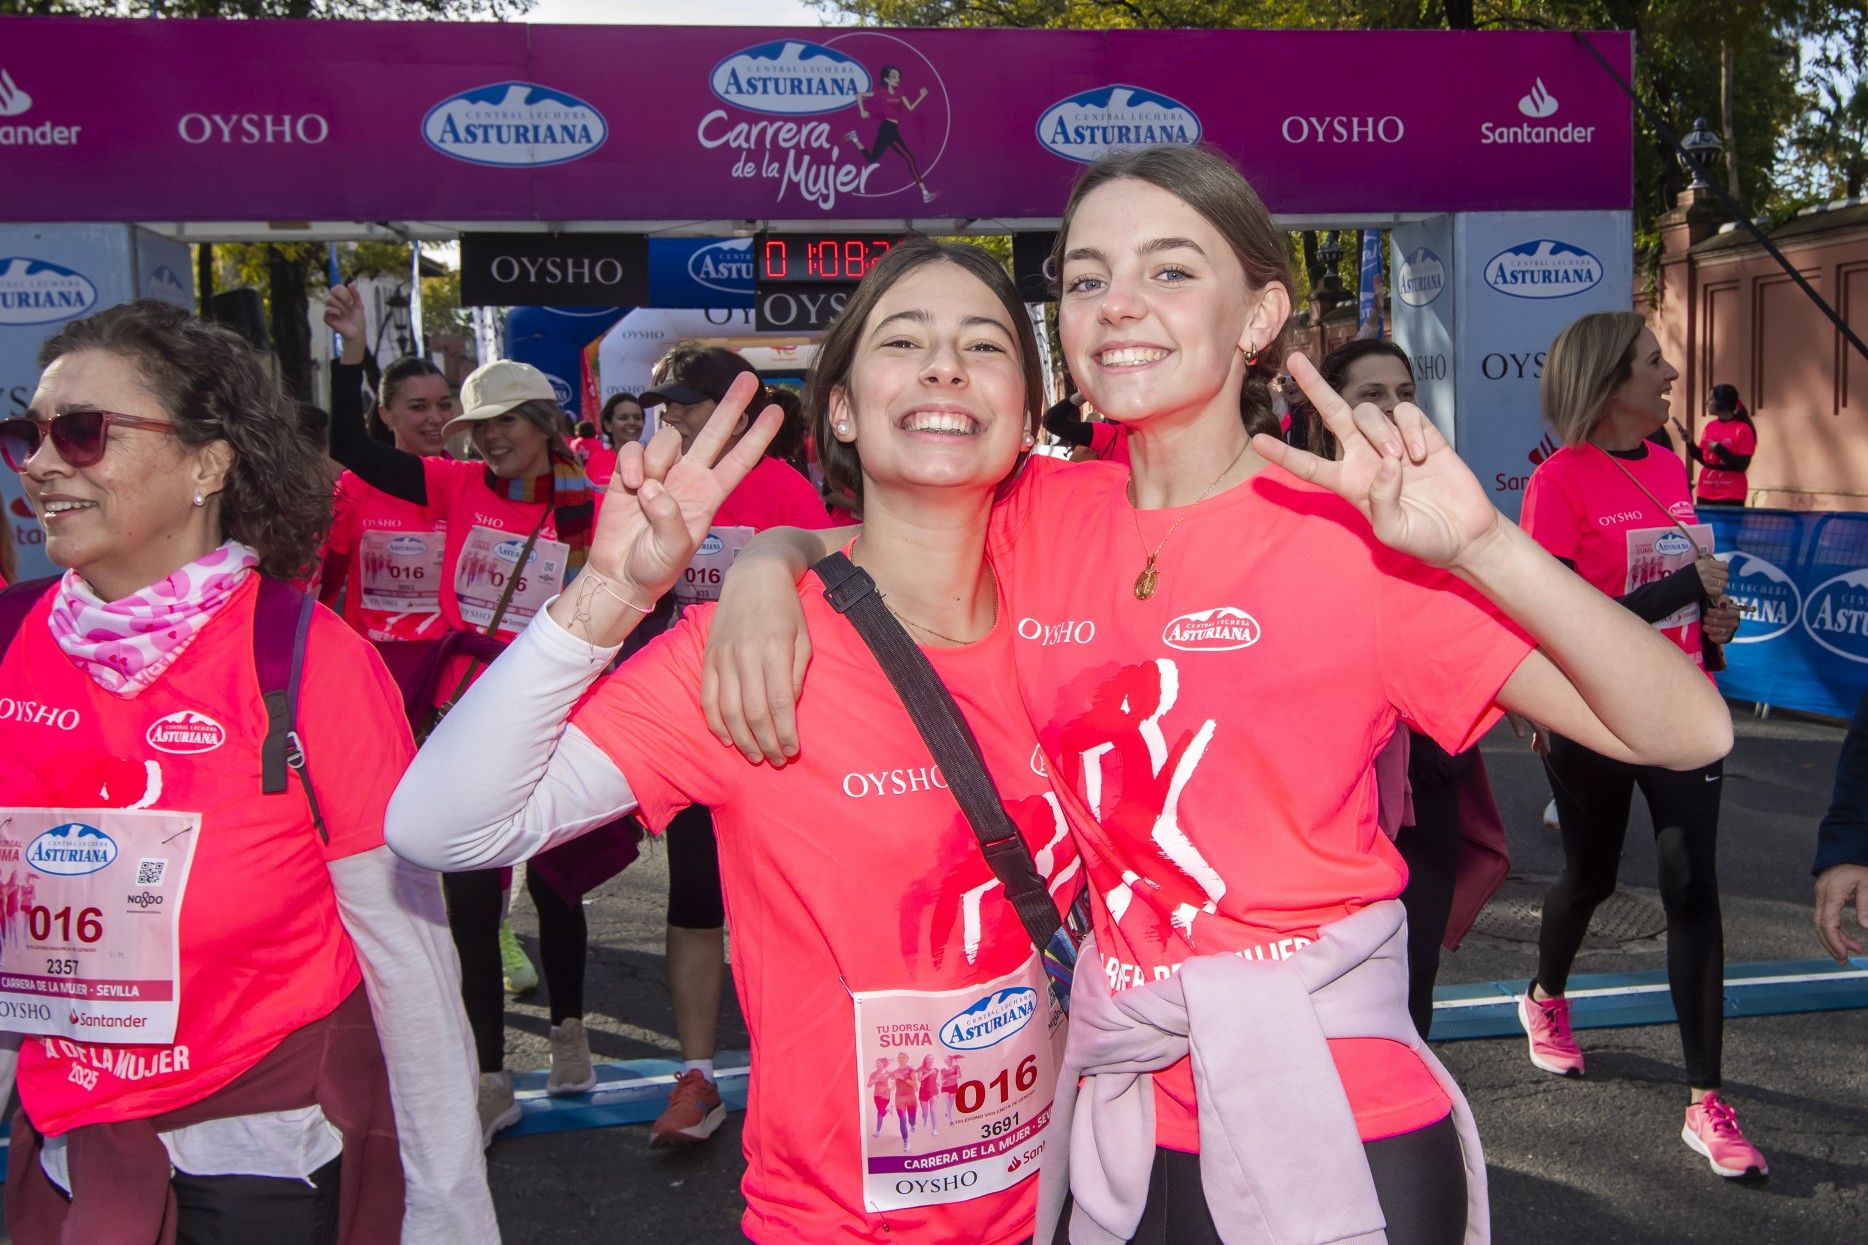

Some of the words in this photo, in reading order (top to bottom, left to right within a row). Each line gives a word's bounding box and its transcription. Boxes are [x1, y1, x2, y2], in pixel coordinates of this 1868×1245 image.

[724, 67, 858, 96] ASTURIANA
[0, 121, 81, 145] ander
[178, 113, 329, 144] OYSHO
[438, 113, 594, 144] ASTURIANA
[698, 110, 832, 149] Carrera
[1051, 115, 1190, 145] ASTURIANA
[1282, 116, 1405, 143] OYSHO
[1481, 122, 1595, 144] Santander
[732, 151, 757, 177] de
[762, 151, 780, 177] la
[777, 145, 881, 210] Mujer
[491, 256, 623, 285] OYSHO
[1493, 262, 1595, 285] ASTURIANA
[1401, 273, 1441, 294] ASTURIANA
[0, 290, 86, 308] URIANA
[622, 330, 665, 340] OYSHO
[1482, 352, 1547, 380] OYS
[474, 511, 504, 529] SHO
[1599, 510, 1643, 527] OYSHO
[390, 566, 424, 580] 016
[685, 567, 720, 584] 016
[1018, 617, 1096, 646] OYSHO
[1168, 623, 1251, 642] ASTURIANA
[151, 725, 218, 745] ASTURIANA
[0, 848, 20, 861] MA
[31, 842, 108, 863] ASTURIANA
[30, 905, 103, 943] 016
[47, 959, 79, 975] 2357
[2, 977, 36, 991] CARRERA
[37, 980, 48, 992] DE
[50, 982, 60, 993] LA
[60, 983, 88, 996] MUJER
[96, 984, 140, 997] SEVILLA
[80, 1012, 148, 1028] Santander
[966, 1010, 997, 1026] CENTRAL
[999, 994, 1033, 1014] LECHERA
[877, 1026, 890, 1034] TU
[892, 1024, 931, 1033] DORSAL
[949, 1000, 1035, 1045] ASTURIANA
[879, 1032, 933, 1048] SUMA
[113, 1045, 190, 1081] MUJER
[68, 1061, 100, 1092] 2025
[955, 1054, 1038, 1114] 016
[981, 1111, 1020, 1139] 3691
[904, 1153, 959, 1170] CARRERA
[962, 1147, 978, 1159] DE
[981, 1143, 996, 1156] LA
[998, 1126, 1031, 1152] MUJER
[895, 1170, 978, 1195] OYSHO
